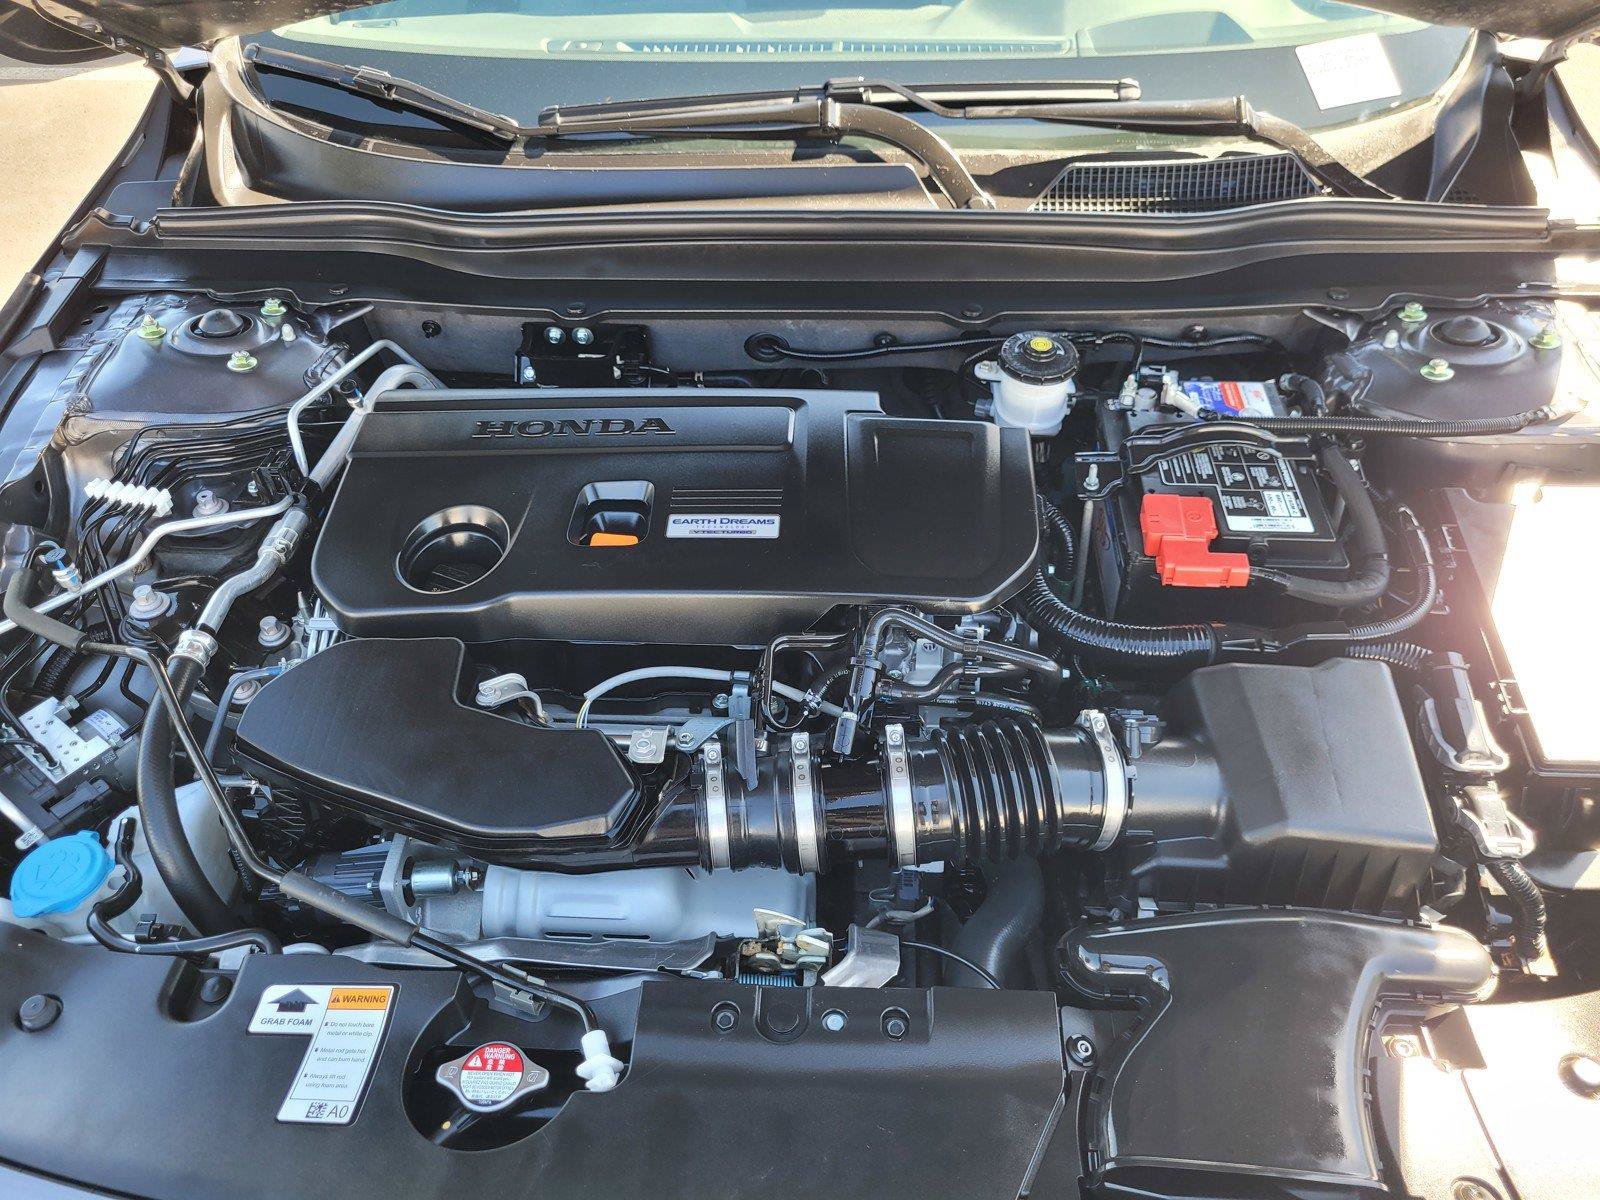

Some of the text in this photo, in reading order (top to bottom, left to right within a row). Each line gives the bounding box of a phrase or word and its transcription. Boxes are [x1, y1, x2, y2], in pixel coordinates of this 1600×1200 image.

[473, 417, 677, 438] HONDA
[719, 517, 776, 525] DREAMS
[342, 995, 387, 1004] WARNING
[287, 1018, 314, 1026] FOAM
[326, 1105, 349, 1119] A0
